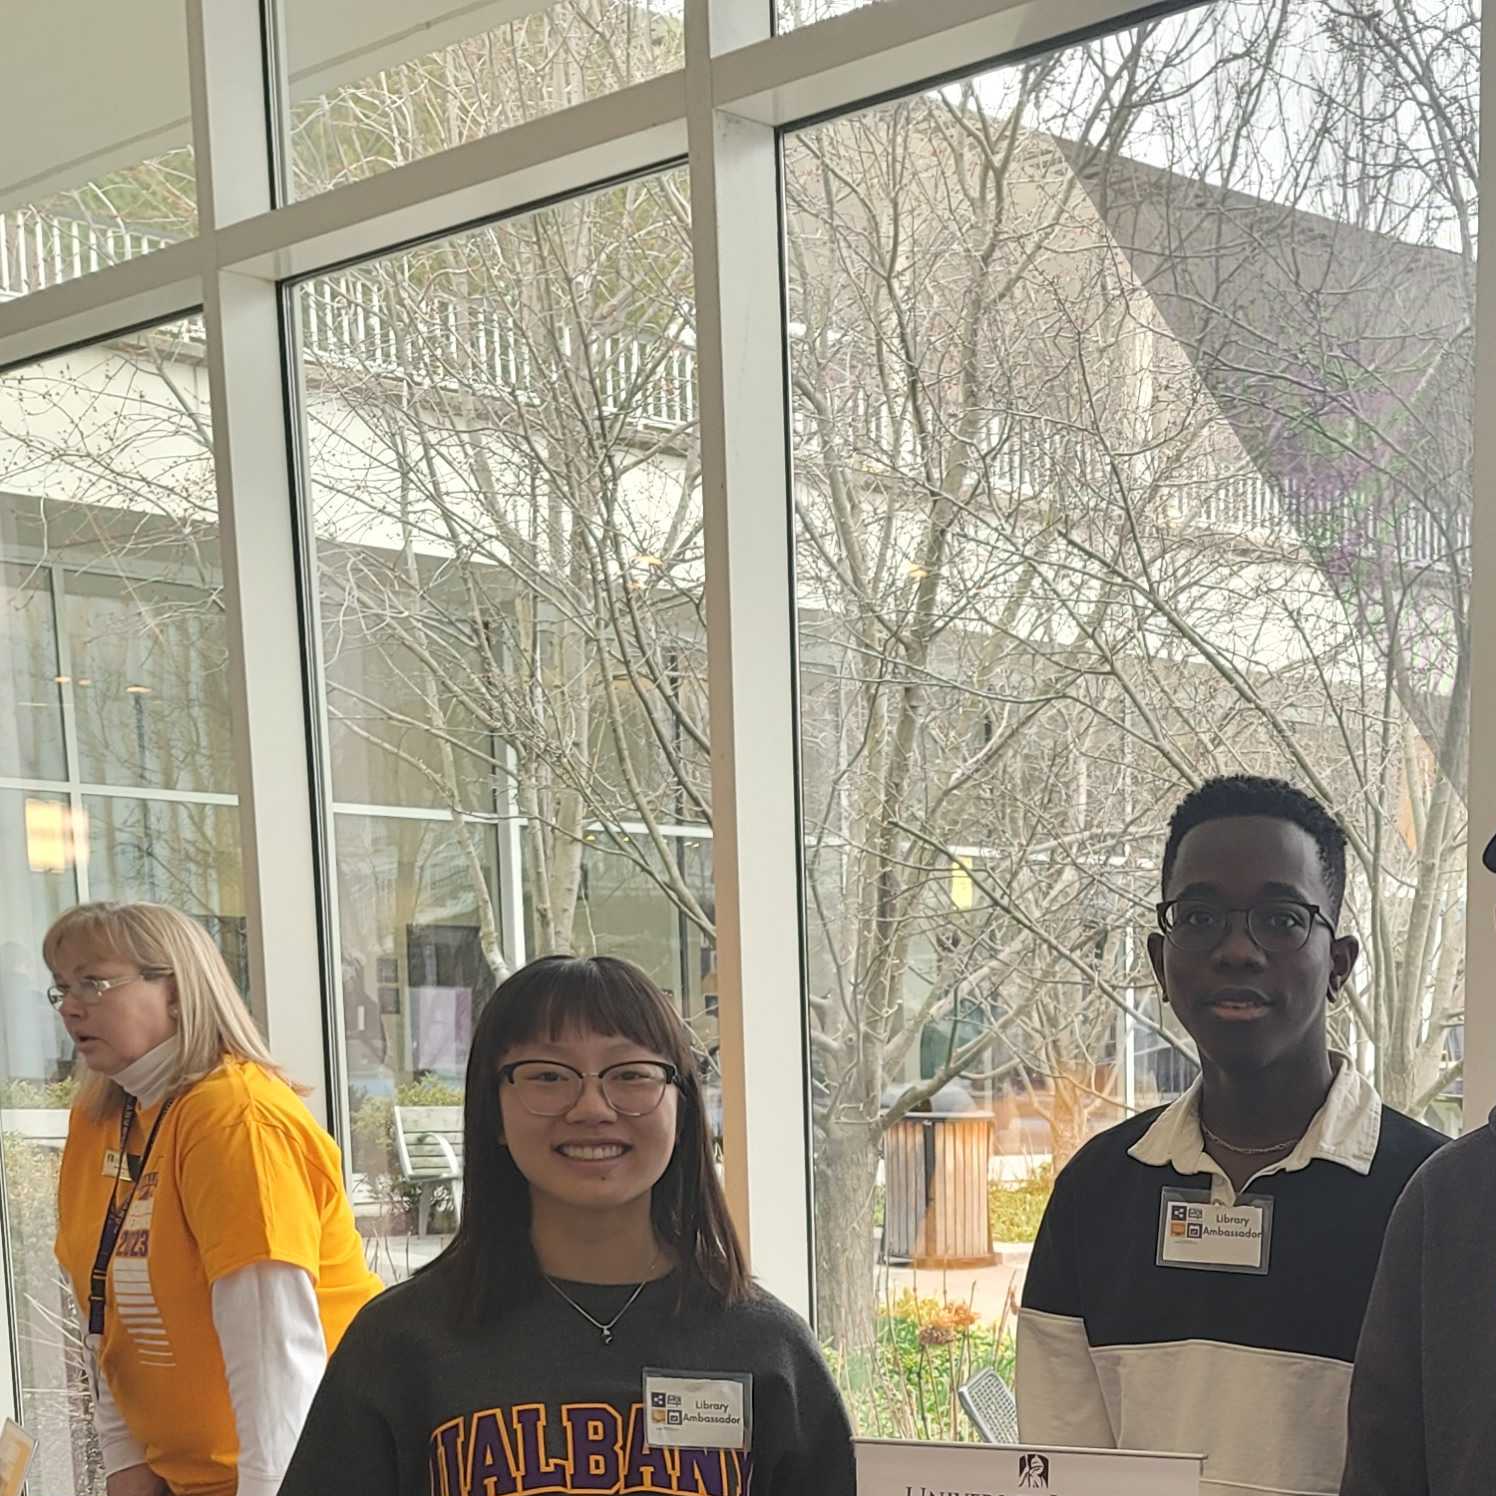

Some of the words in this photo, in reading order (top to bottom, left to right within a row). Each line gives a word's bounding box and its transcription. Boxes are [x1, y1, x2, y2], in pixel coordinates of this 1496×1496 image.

[1216, 1213, 1250, 1226] Library
[1202, 1226, 1263, 1239] Ambassador
[695, 1400, 729, 1414] Library
[683, 1412, 741, 1425] Ambassador
